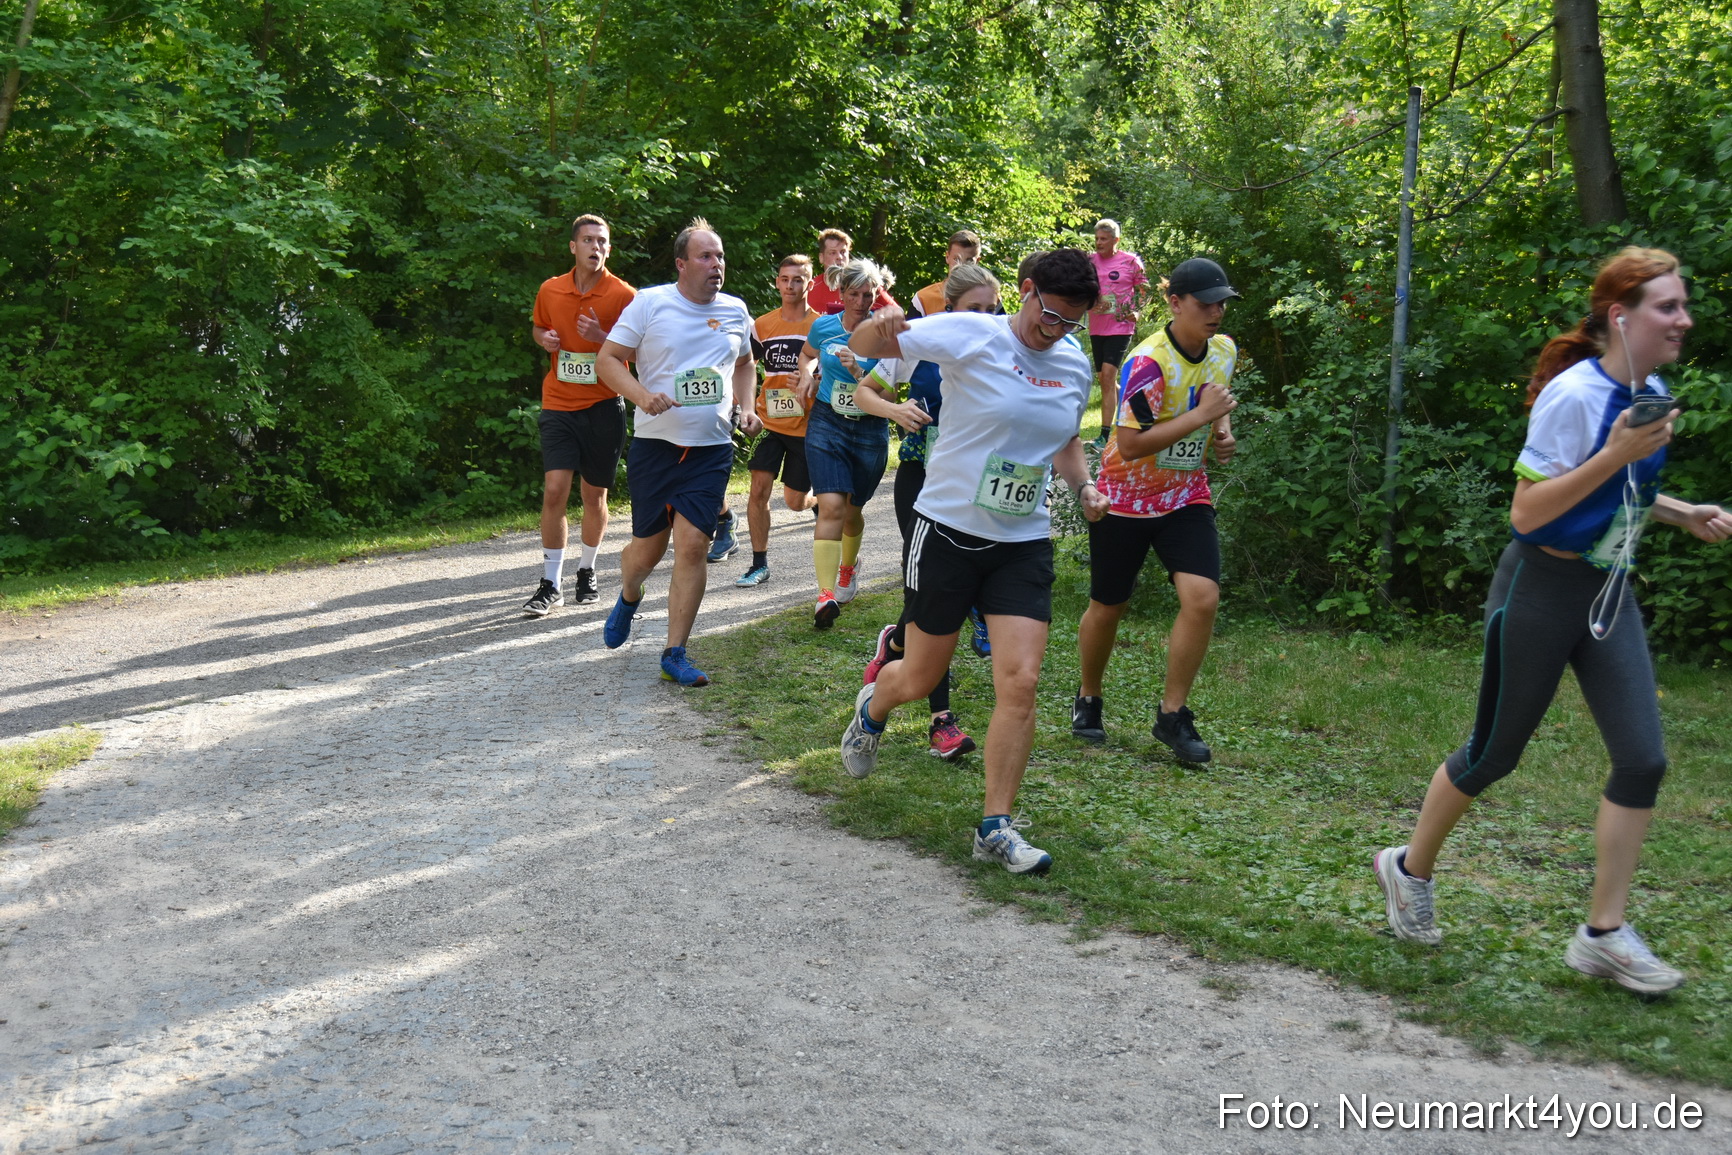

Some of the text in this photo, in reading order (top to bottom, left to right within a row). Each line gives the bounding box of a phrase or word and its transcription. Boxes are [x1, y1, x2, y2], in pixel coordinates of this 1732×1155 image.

[561, 361, 592, 376] 1803
[681, 380, 717, 396] 1331
[773, 399, 794, 410] 750
[1168, 441, 1203, 458] 1325
[990, 477, 1037, 503] 1166
